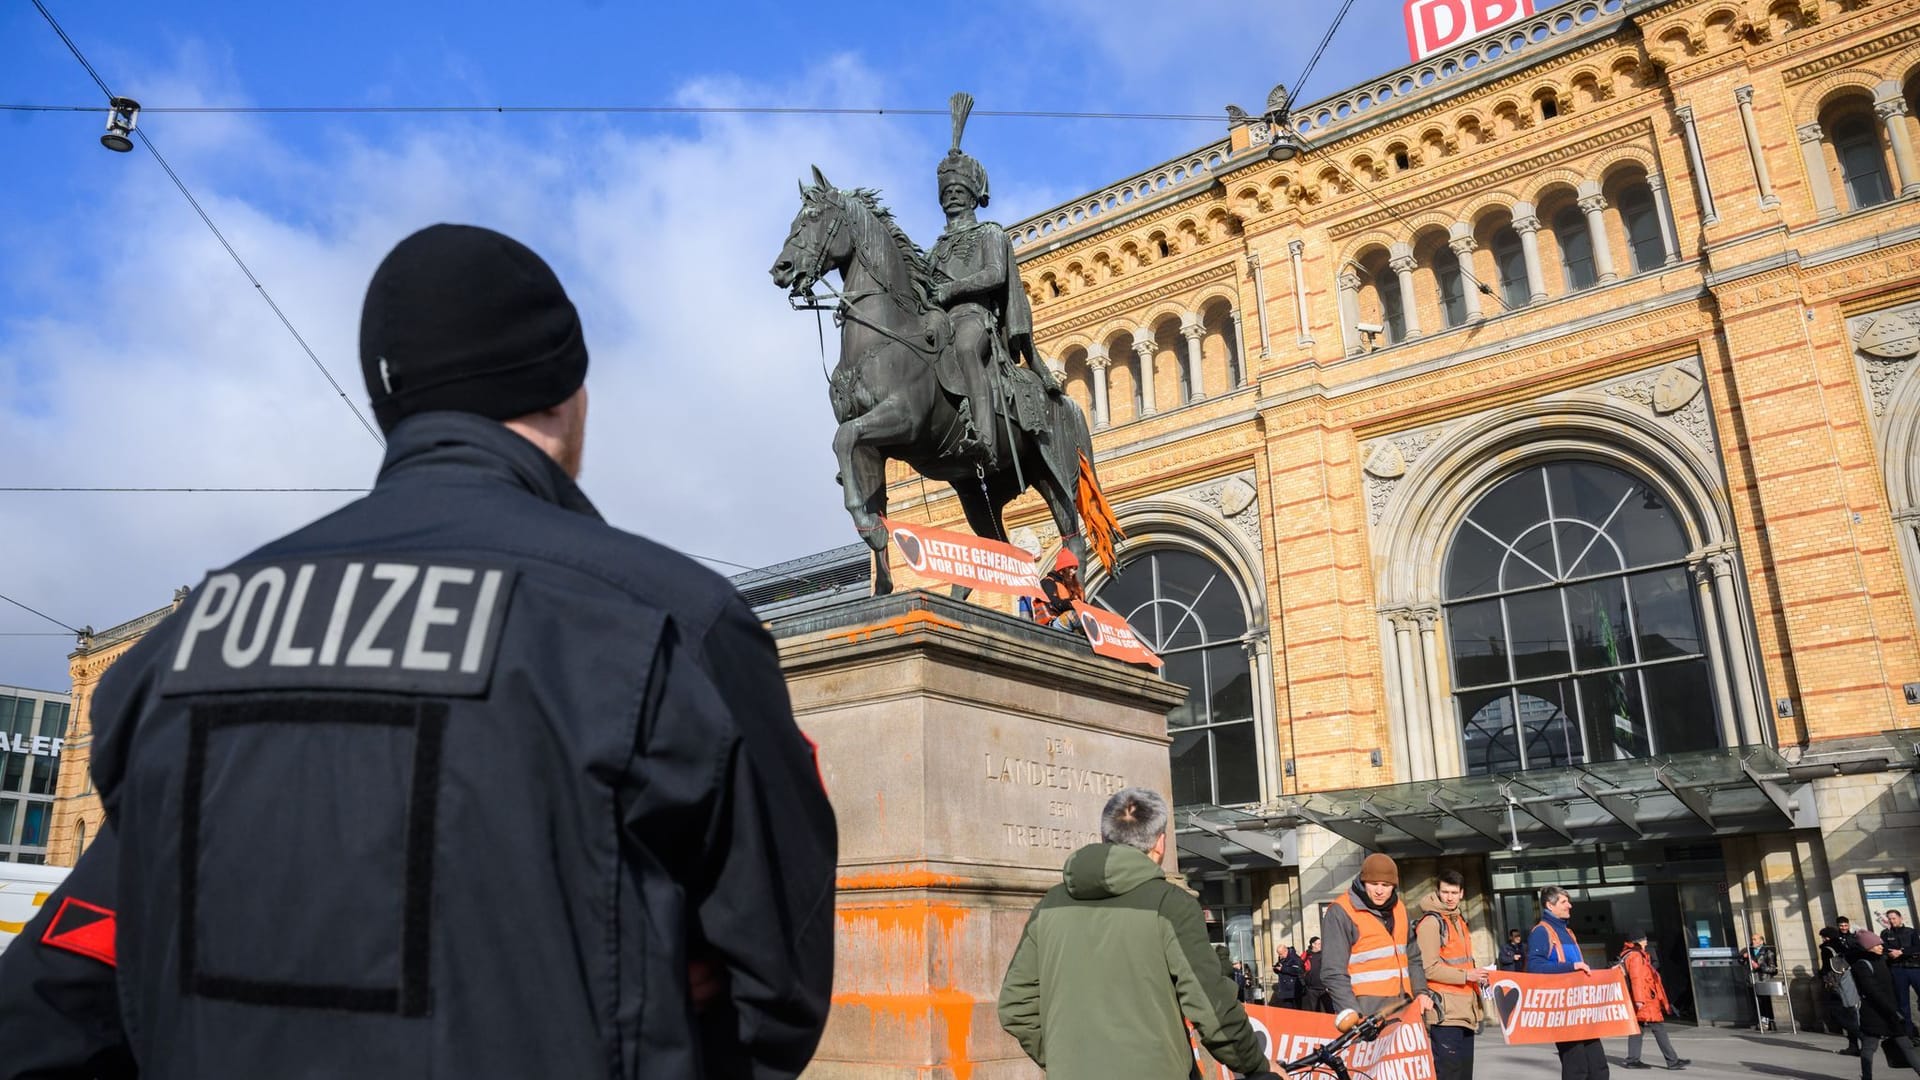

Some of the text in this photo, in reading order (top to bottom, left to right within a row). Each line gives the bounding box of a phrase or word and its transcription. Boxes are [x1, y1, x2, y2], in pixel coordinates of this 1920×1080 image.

[1419, 0, 1518, 52] DB
[924, 538, 1039, 577] LETZTE GENERATION
[928, 557, 953, 575] VOR
[954, 561, 977, 580] DEN
[173, 562, 503, 674] POLIZEI
[1045, 737, 1074, 757] DEM
[985, 752, 1129, 797] LANDESVATER
[1049, 800, 1078, 819] SEIN
[1002, 823, 1072, 850] TREUES
[1524, 982, 1624, 1009] LETZTE GENERATION
[1520, 1003, 1629, 1028] VOR DEN KIPPPUNKTEN
